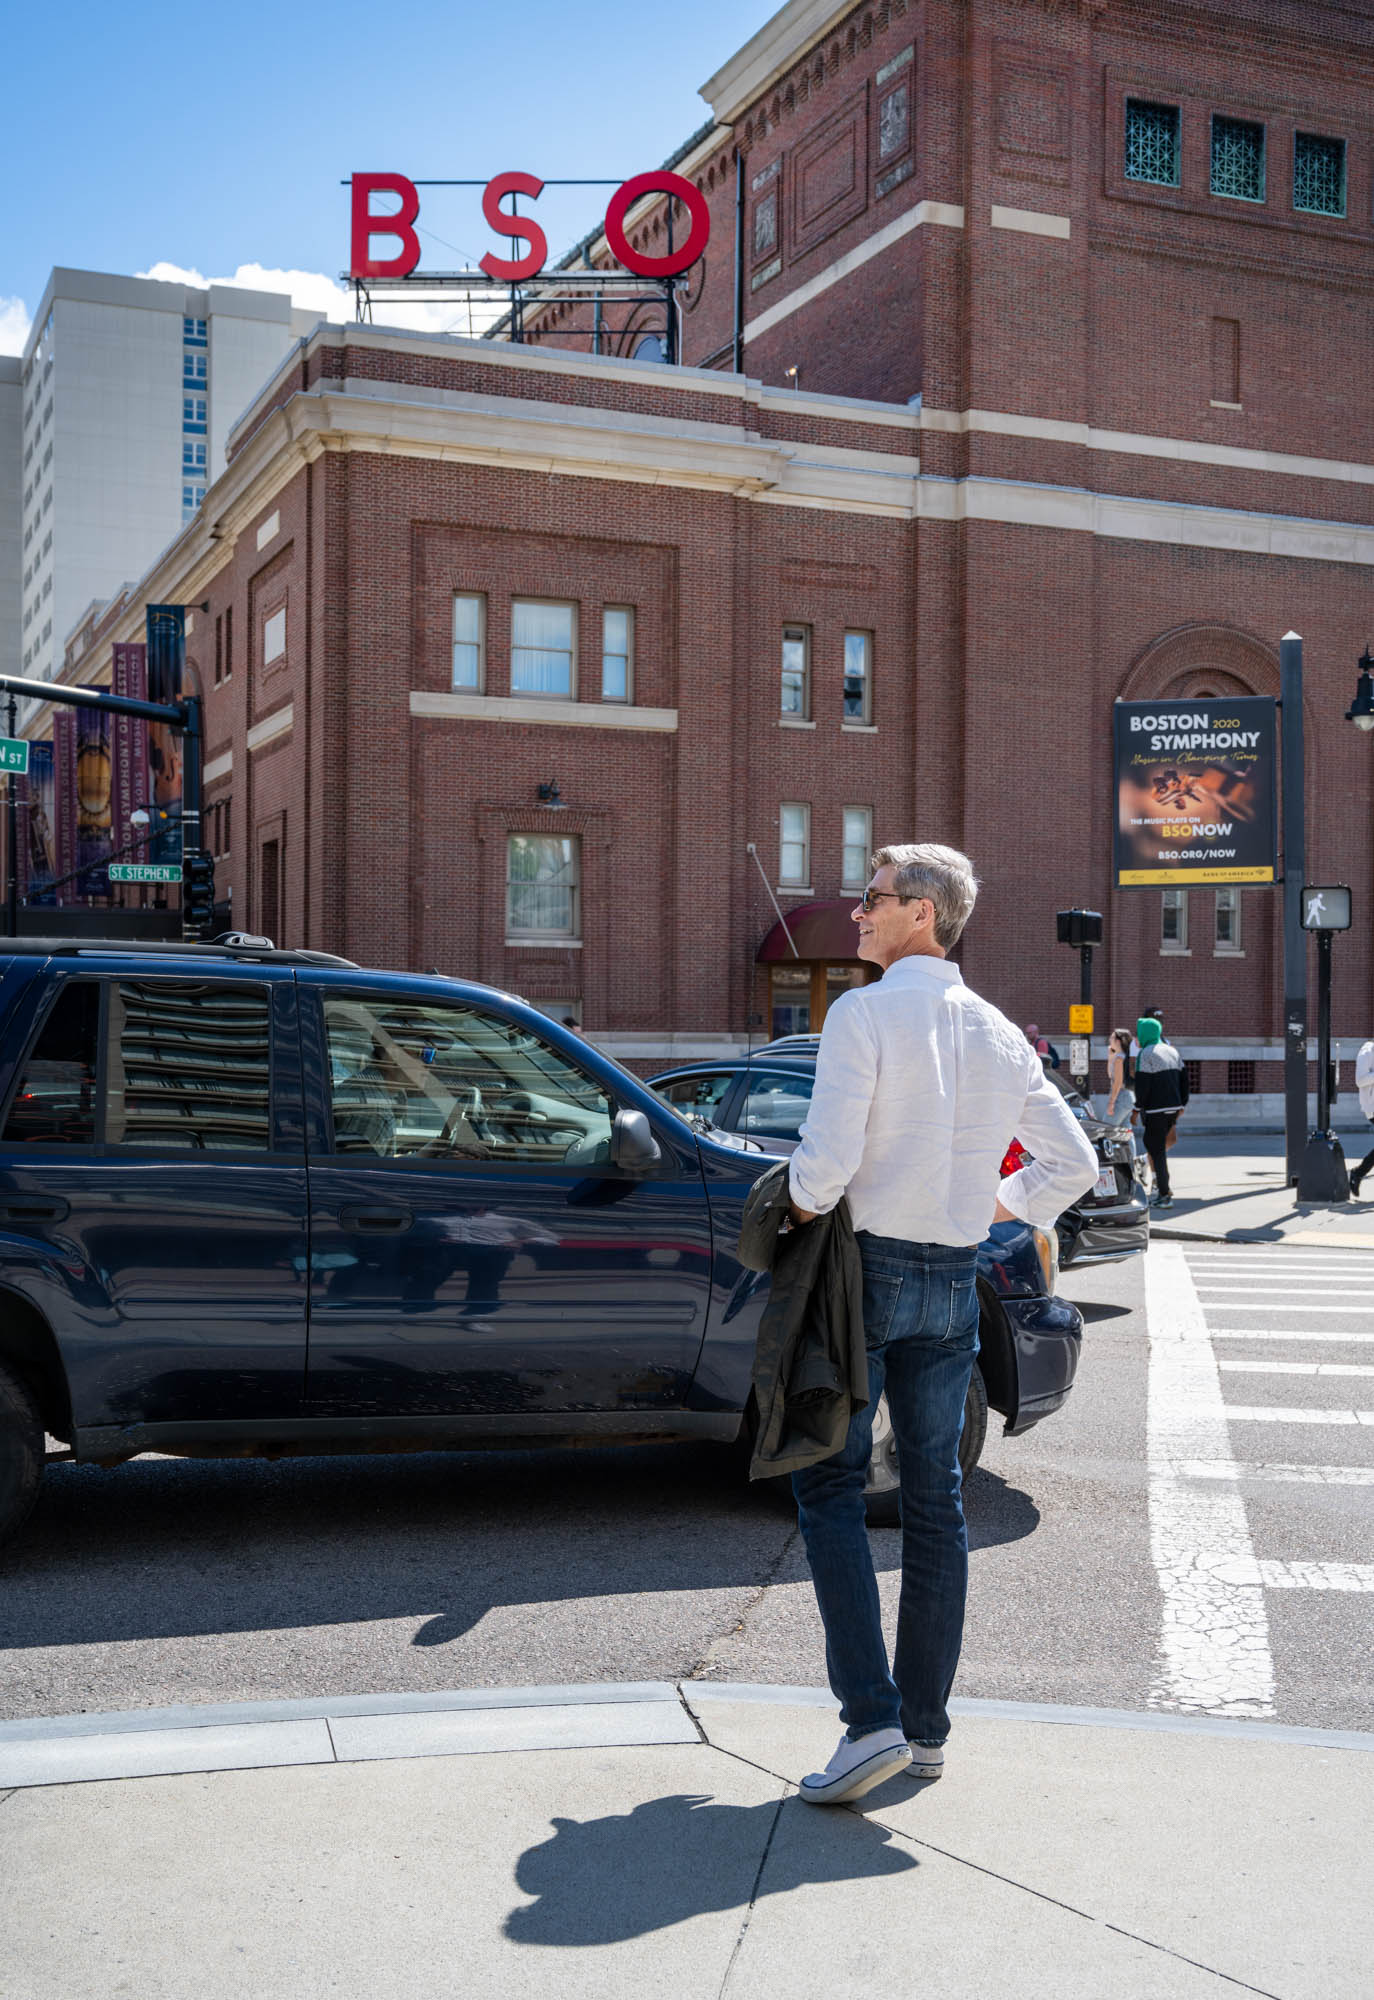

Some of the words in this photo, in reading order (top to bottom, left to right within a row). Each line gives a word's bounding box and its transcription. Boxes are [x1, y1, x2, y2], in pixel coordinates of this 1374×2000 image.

[117, 653, 128, 736] ORESTRA
[1130, 714, 1208, 732] BOSTON
[1213, 719, 1240, 729] 2020
[1151, 732, 1261, 750] SYMPHONY
[9, 753, 22, 765] ST
[118, 739, 131, 817] SYMPHONY
[1130, 817, 1143, 825] THE
[1144, 817, 1167, 825] MUSIC
[1168, 816, 1187, 824] PLAYS
[1189, 816, 1200, 824] ON
[1158, 849, 1236, 860] BSO.ORG/NOW
[127, 867, 169, 880] STEPHEN
